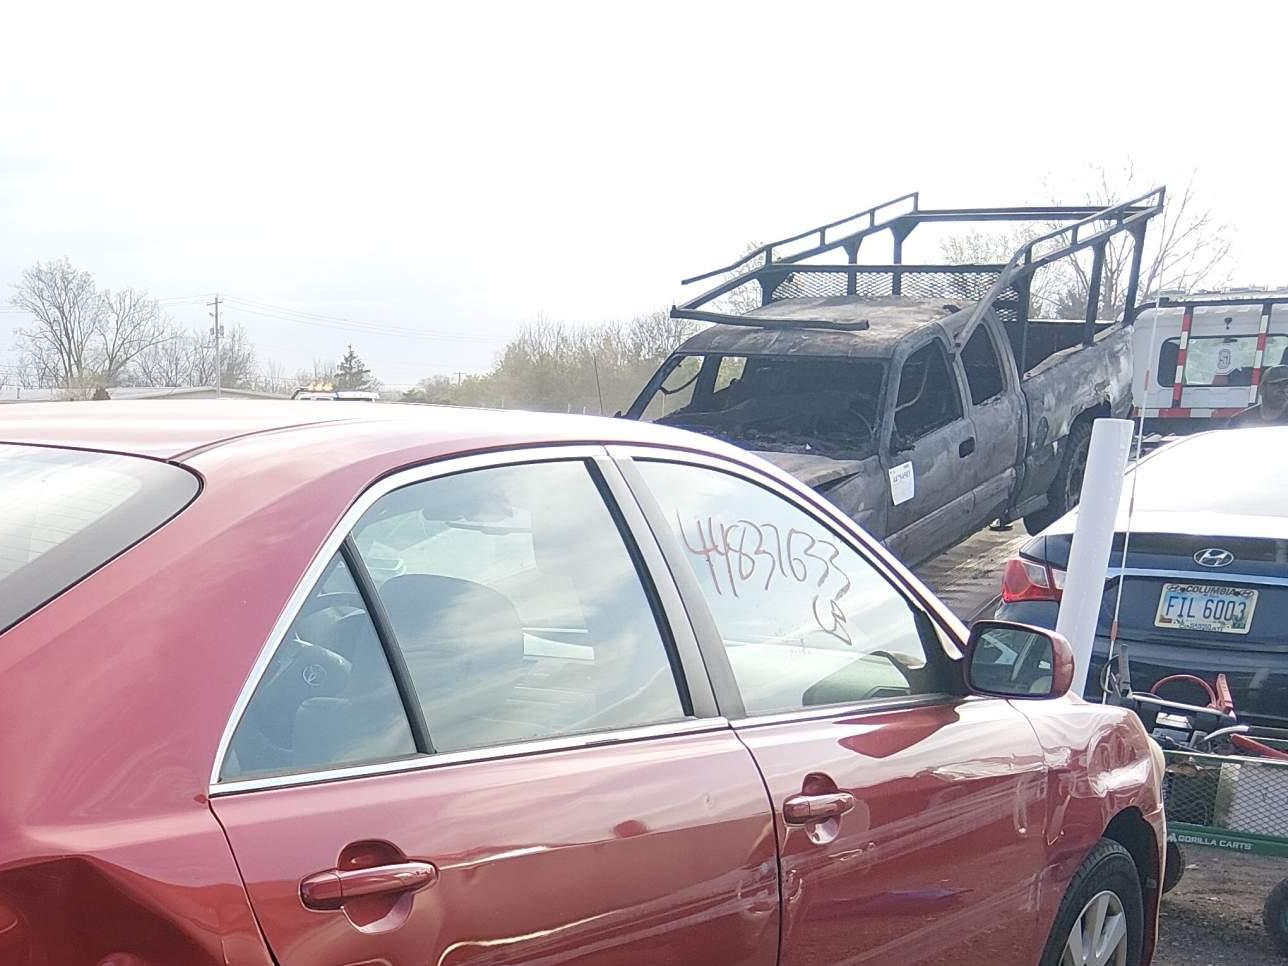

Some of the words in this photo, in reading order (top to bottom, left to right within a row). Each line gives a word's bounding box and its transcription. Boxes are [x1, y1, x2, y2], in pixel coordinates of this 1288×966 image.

[676, 508, 851, 602] 44837633
[1187, 584, 1235, 596] COLUMBIA
[1165, 596, 1196, 618] FIL
[1203, 599, 1247, 622] 6003
[1178, 834, 1217, 846] GORILLA
[1219, 840, 1252, 850] CARTS
